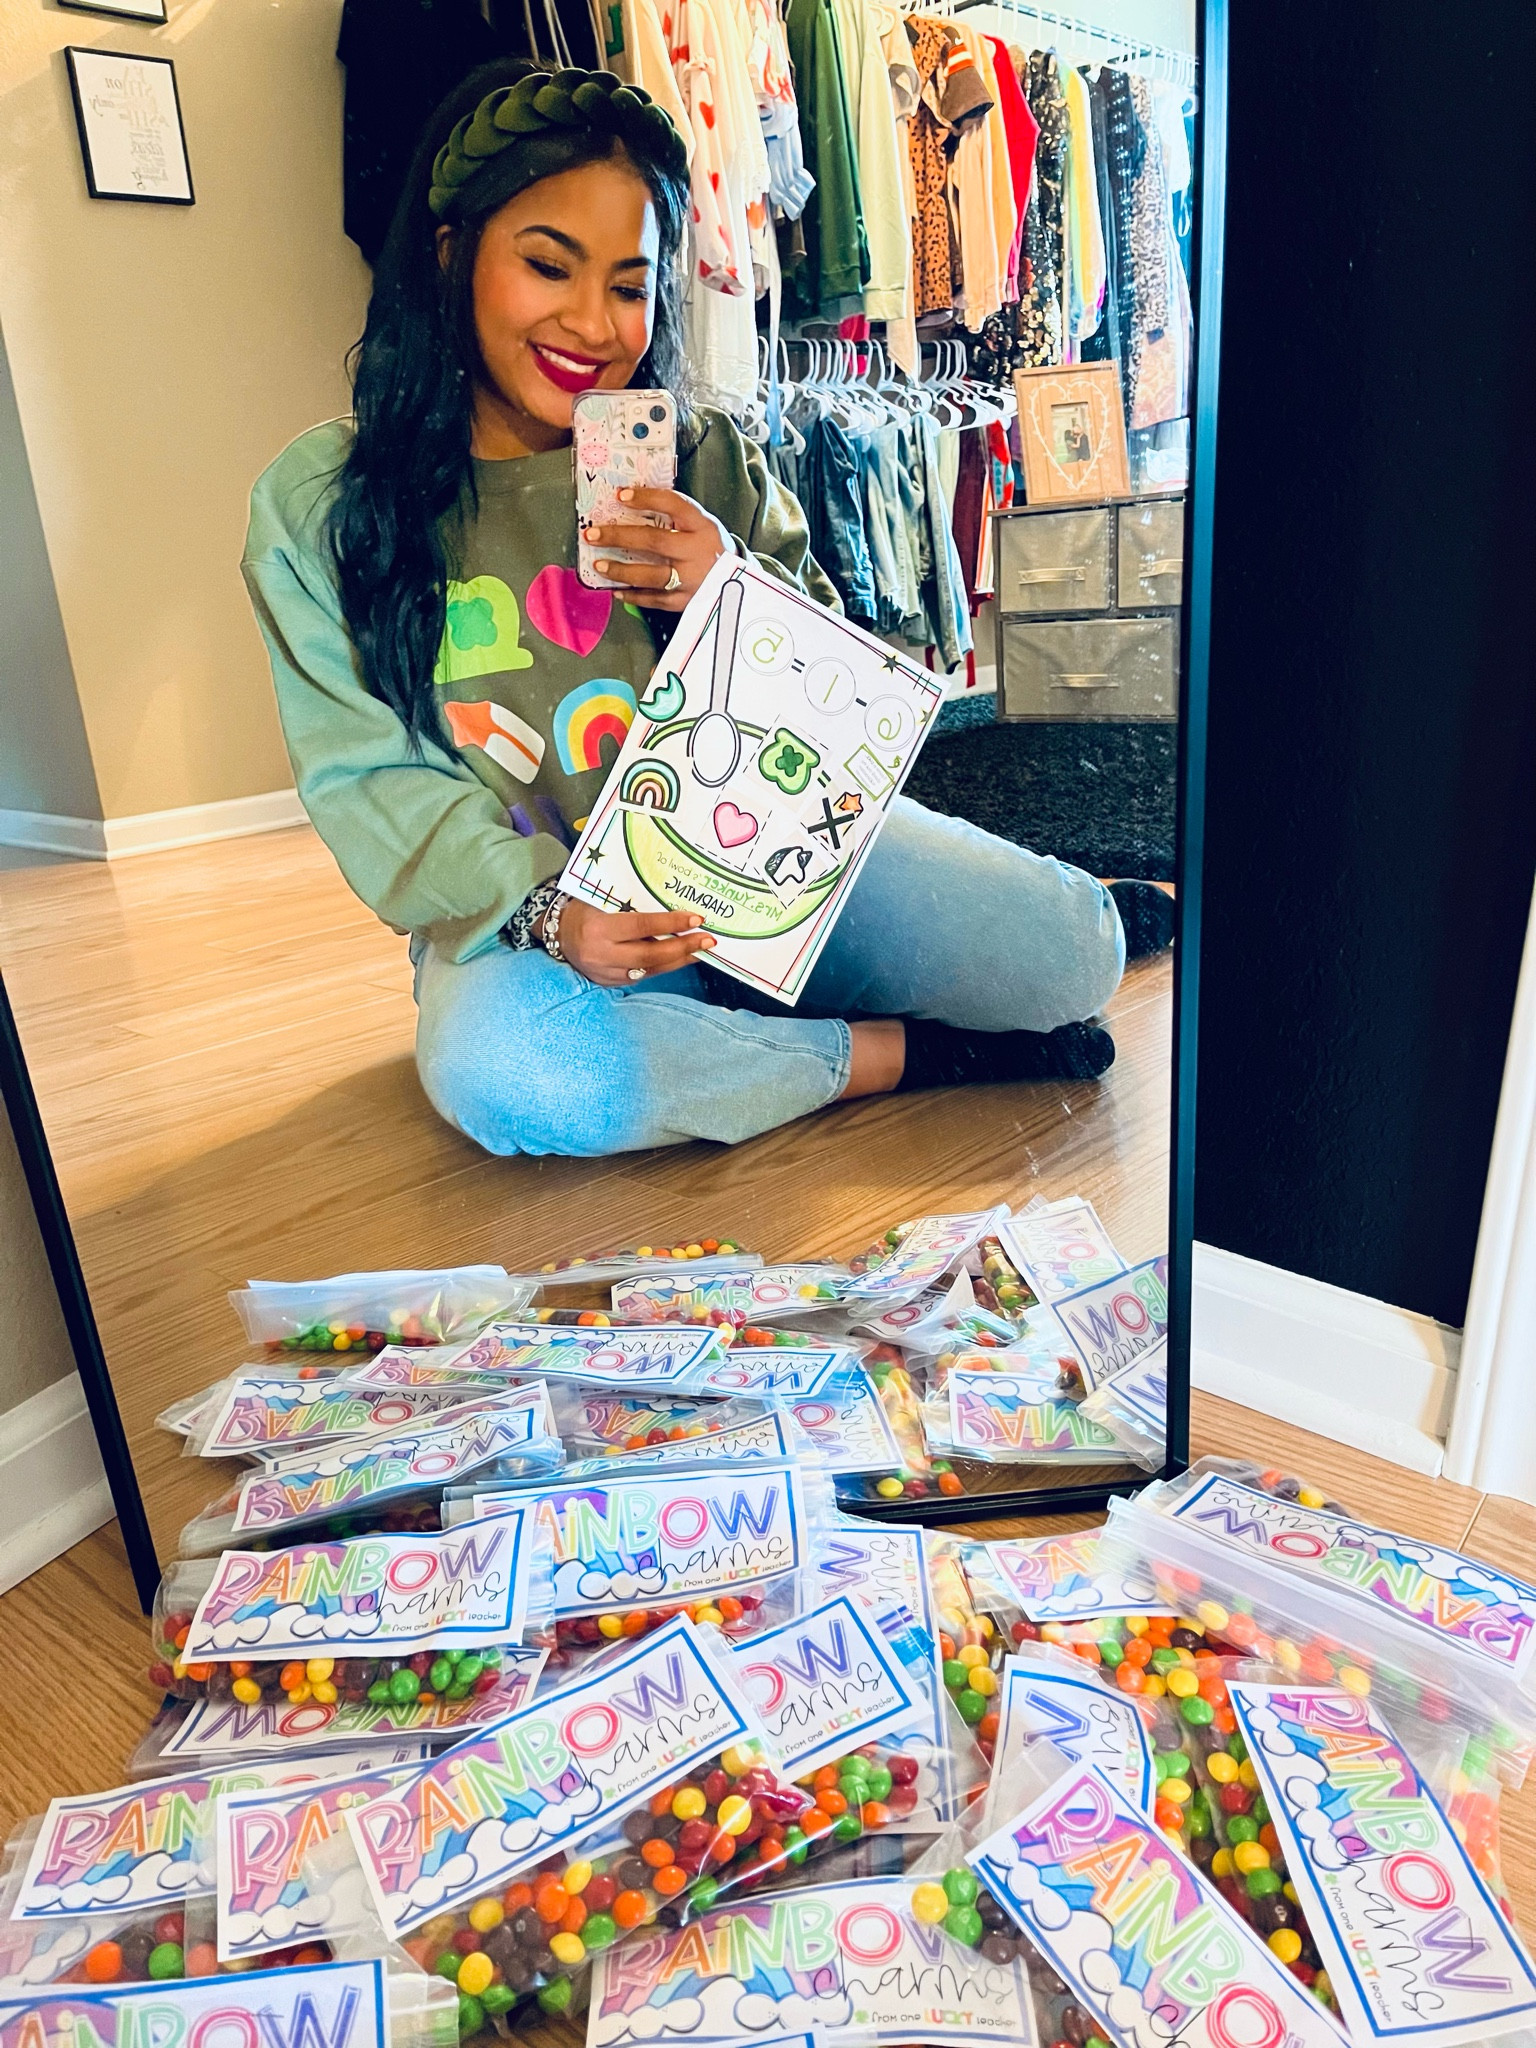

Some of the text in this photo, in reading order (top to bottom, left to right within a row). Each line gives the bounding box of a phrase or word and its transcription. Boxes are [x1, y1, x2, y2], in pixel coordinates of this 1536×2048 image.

[534, 1485, 780, 1562] AiNBOW
[637, 1533, 790, 1582] charms
[722, 1564, 761, 1582] LUCKY
[761, 1559, 793, 1574] teacher
[355, 1571, 507, 1620] charms
[429, 1609, 467, 1627] LUCKY
[558, 1692, 720, 1799] charms
[784, 1695, 895, 1755] from one LUCKY teacher
[617, 1720, 732, 1797] from one LUCKY teacher
[1029, 1773, 1306, 2048] RAiNBO
[1335, 1834, 1446, 2021] charms
[812, 1945, 1016, 2004] charms
[1347, 1931, 1382, 1980] LUCKY
[923, 2008, 975, 2027] LUCKY
